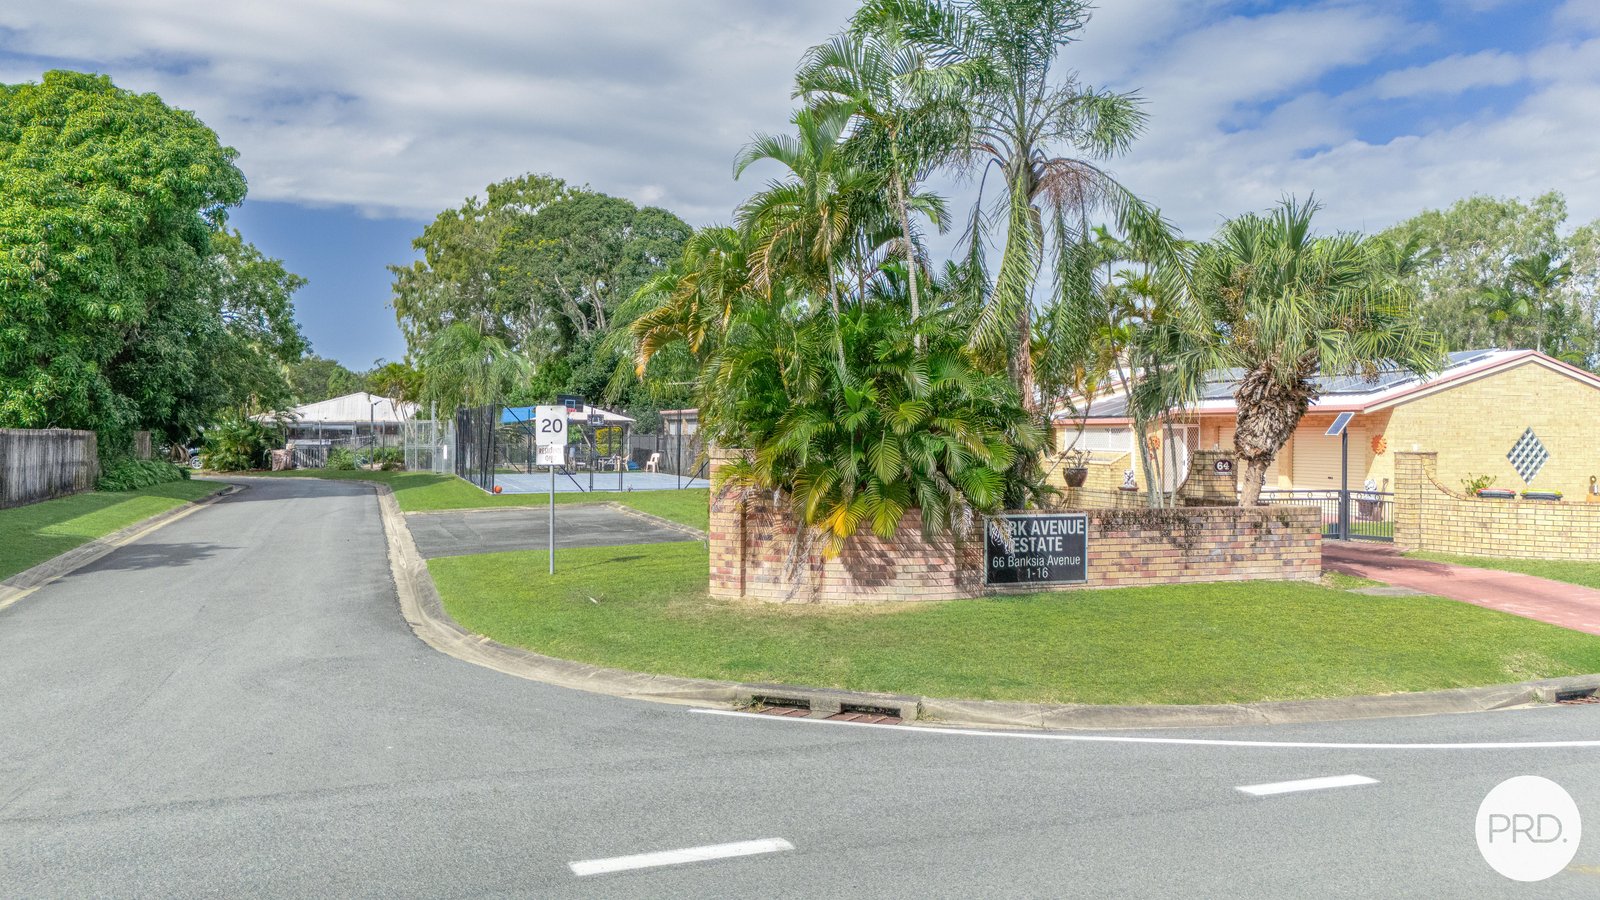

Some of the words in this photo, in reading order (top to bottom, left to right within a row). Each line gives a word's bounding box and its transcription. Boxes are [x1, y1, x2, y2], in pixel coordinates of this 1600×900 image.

[542, 419, 562, 433] 20
[1216, 461, 1230, 471] 64
[989, 519, 1028, 536] RK
[1031, 519, 1084, 535] AVENUE
[1012, 536, 1063, 553] ESTATE
[992, 556, 1005, 568] 66
[1008, 555, 1045, 568] Banksia
[1046, 555, 1081, 566] Avenue
[1027, 567, 1049, 579] 1-16
